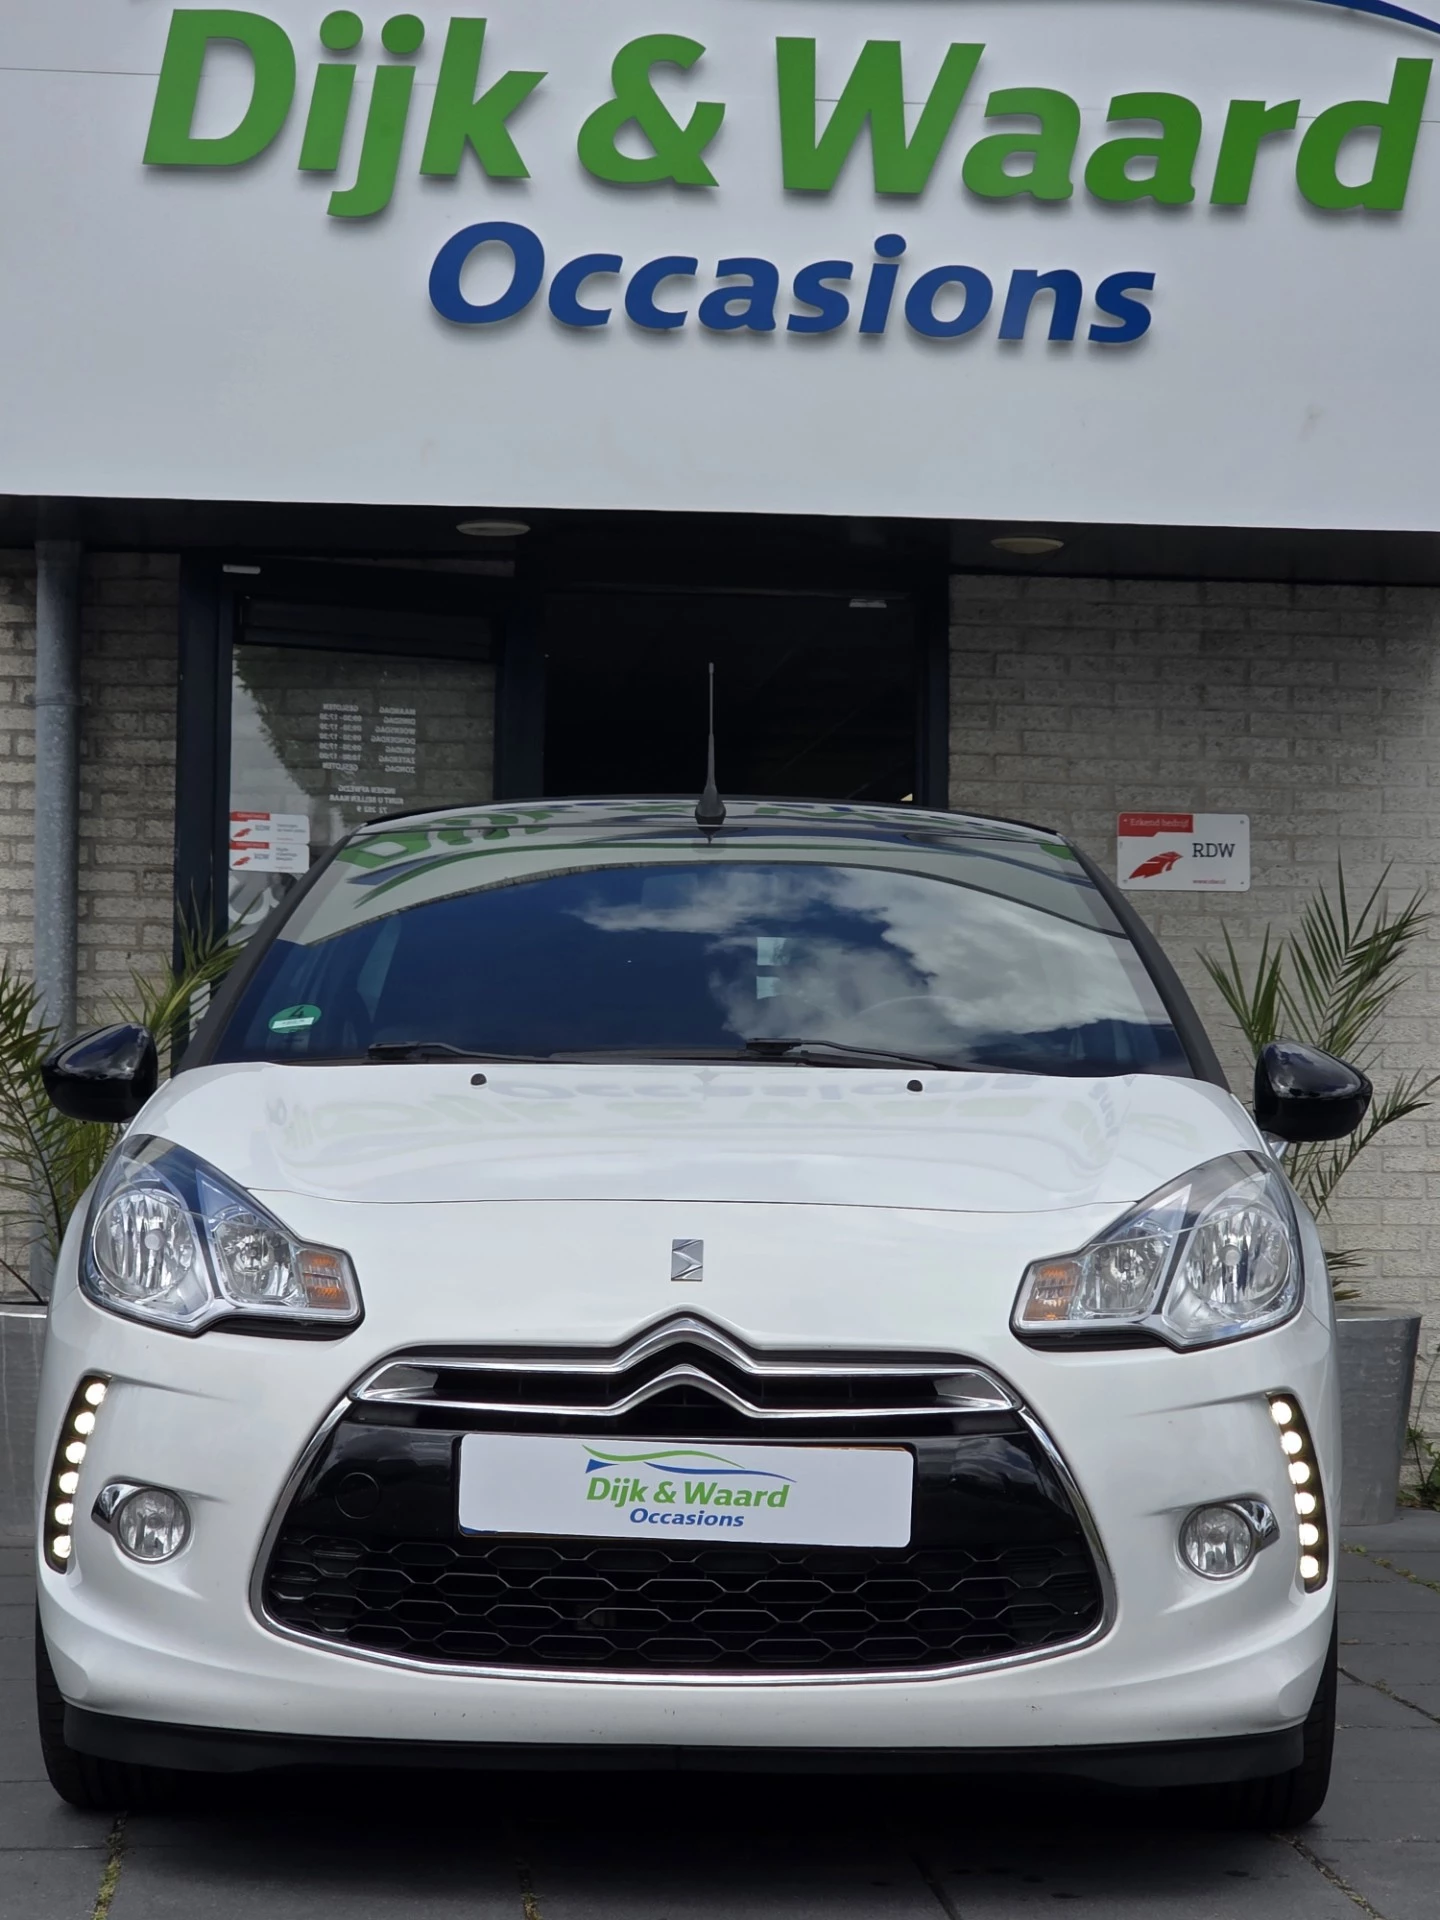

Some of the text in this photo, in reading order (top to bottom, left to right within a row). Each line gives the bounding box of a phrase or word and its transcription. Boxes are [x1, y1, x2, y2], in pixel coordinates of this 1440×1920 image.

[142, 8, 1434, 219] Dijk & Waard
[428, 220, 1156, 344] Occasions
[1129, 818, 1160, 826] Erkend
[1192, 843, 1236, 858] RDW
[586, 1476, 791, 1508] Dijk & Waard
[629, 1507, 745, 1527] Occasions
